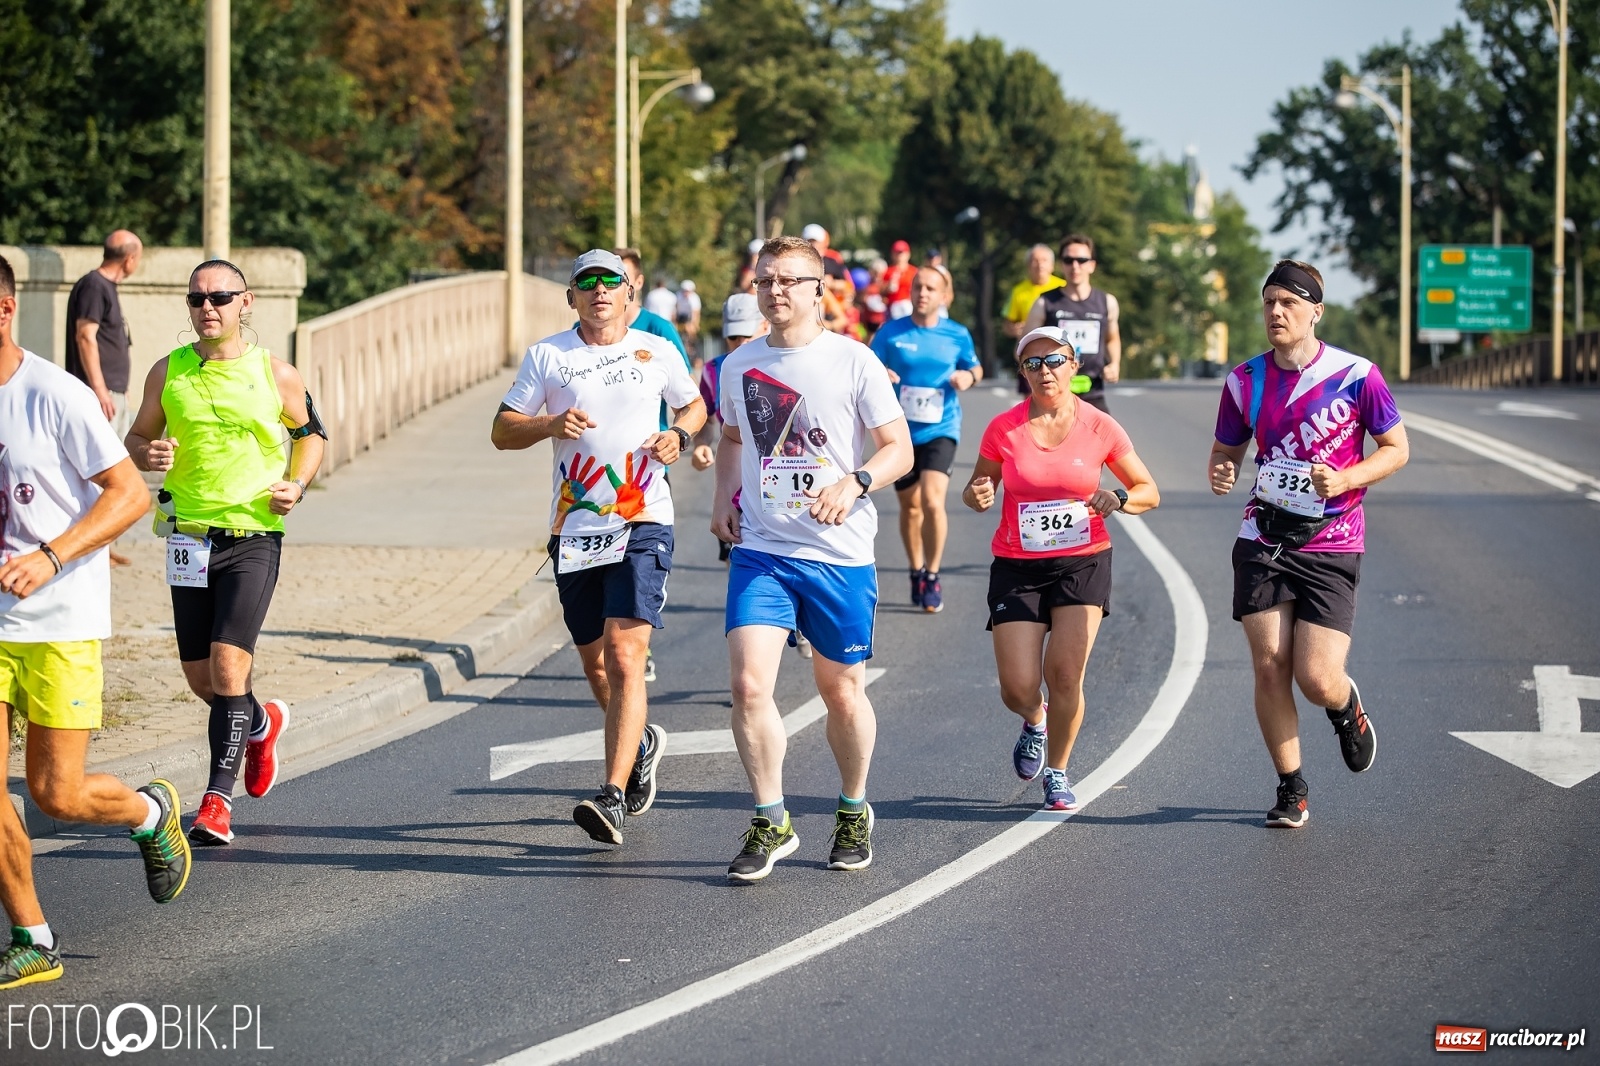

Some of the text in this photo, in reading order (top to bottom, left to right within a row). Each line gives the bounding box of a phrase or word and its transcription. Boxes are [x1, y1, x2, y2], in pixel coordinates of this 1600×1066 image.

[792, 472, 814, 491] 19
[1278, 472, 1312, 494] 332
[1040, 513, 1073, 531] 362
[580, 534, 614, 552] 338
[174, 548, 189, 565] 88
